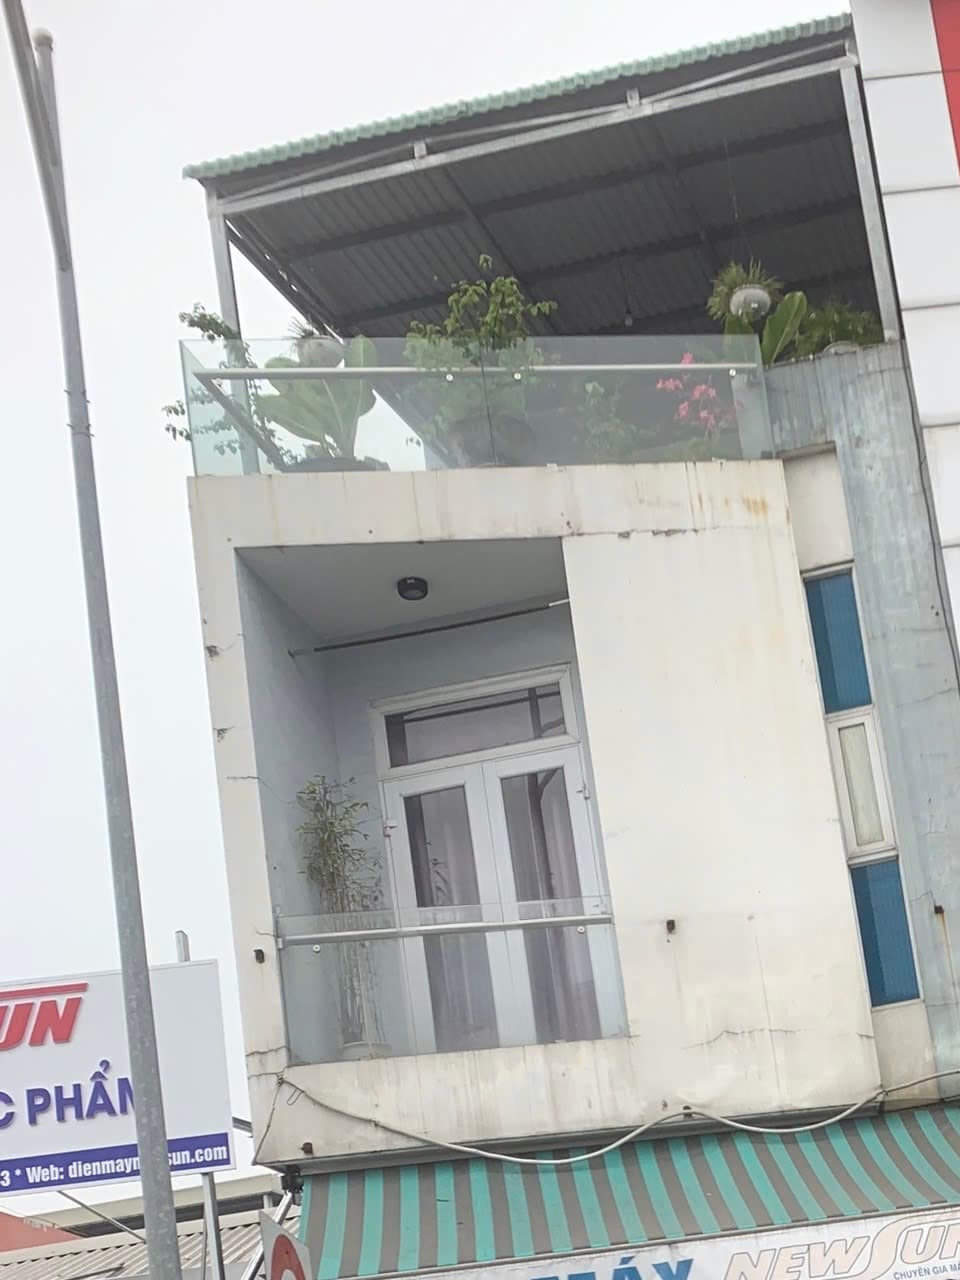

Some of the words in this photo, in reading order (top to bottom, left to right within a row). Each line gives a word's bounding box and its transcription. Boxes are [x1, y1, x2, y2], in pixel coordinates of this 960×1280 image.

[26, 1164, 65, 1184] Web:
[68, 1145, 228, 1178] dienmaynsun.com
[893, 1264, 931, 1280] CHUYÊN
[932, 1265, 949, 1276] GIA
